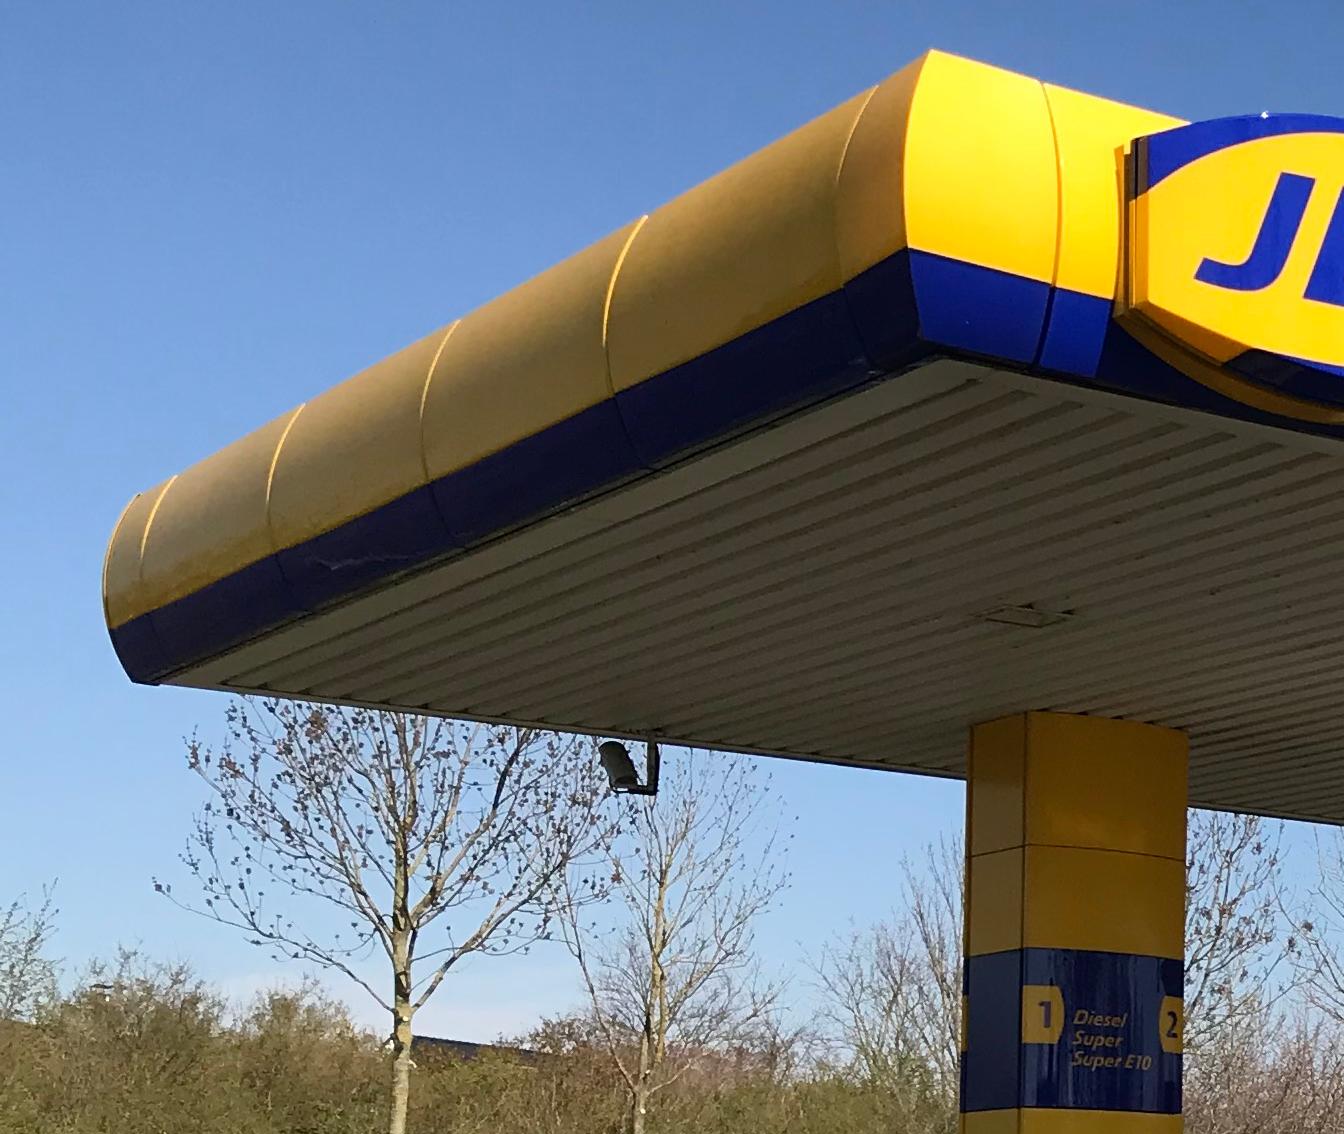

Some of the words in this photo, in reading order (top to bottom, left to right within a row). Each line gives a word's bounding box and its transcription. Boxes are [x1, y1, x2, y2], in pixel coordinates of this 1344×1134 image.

[1038, 1001, 1051, 1028] 1
[1073, 1010, 1128, 1028] Diesel
[1166, 1011, 1178, 1038] 2
[1072, 1030, 1124, 1050] Super
[1072, 1051, 1122, 1071] Super
[1125, 1055, 1152, 1070] E10
